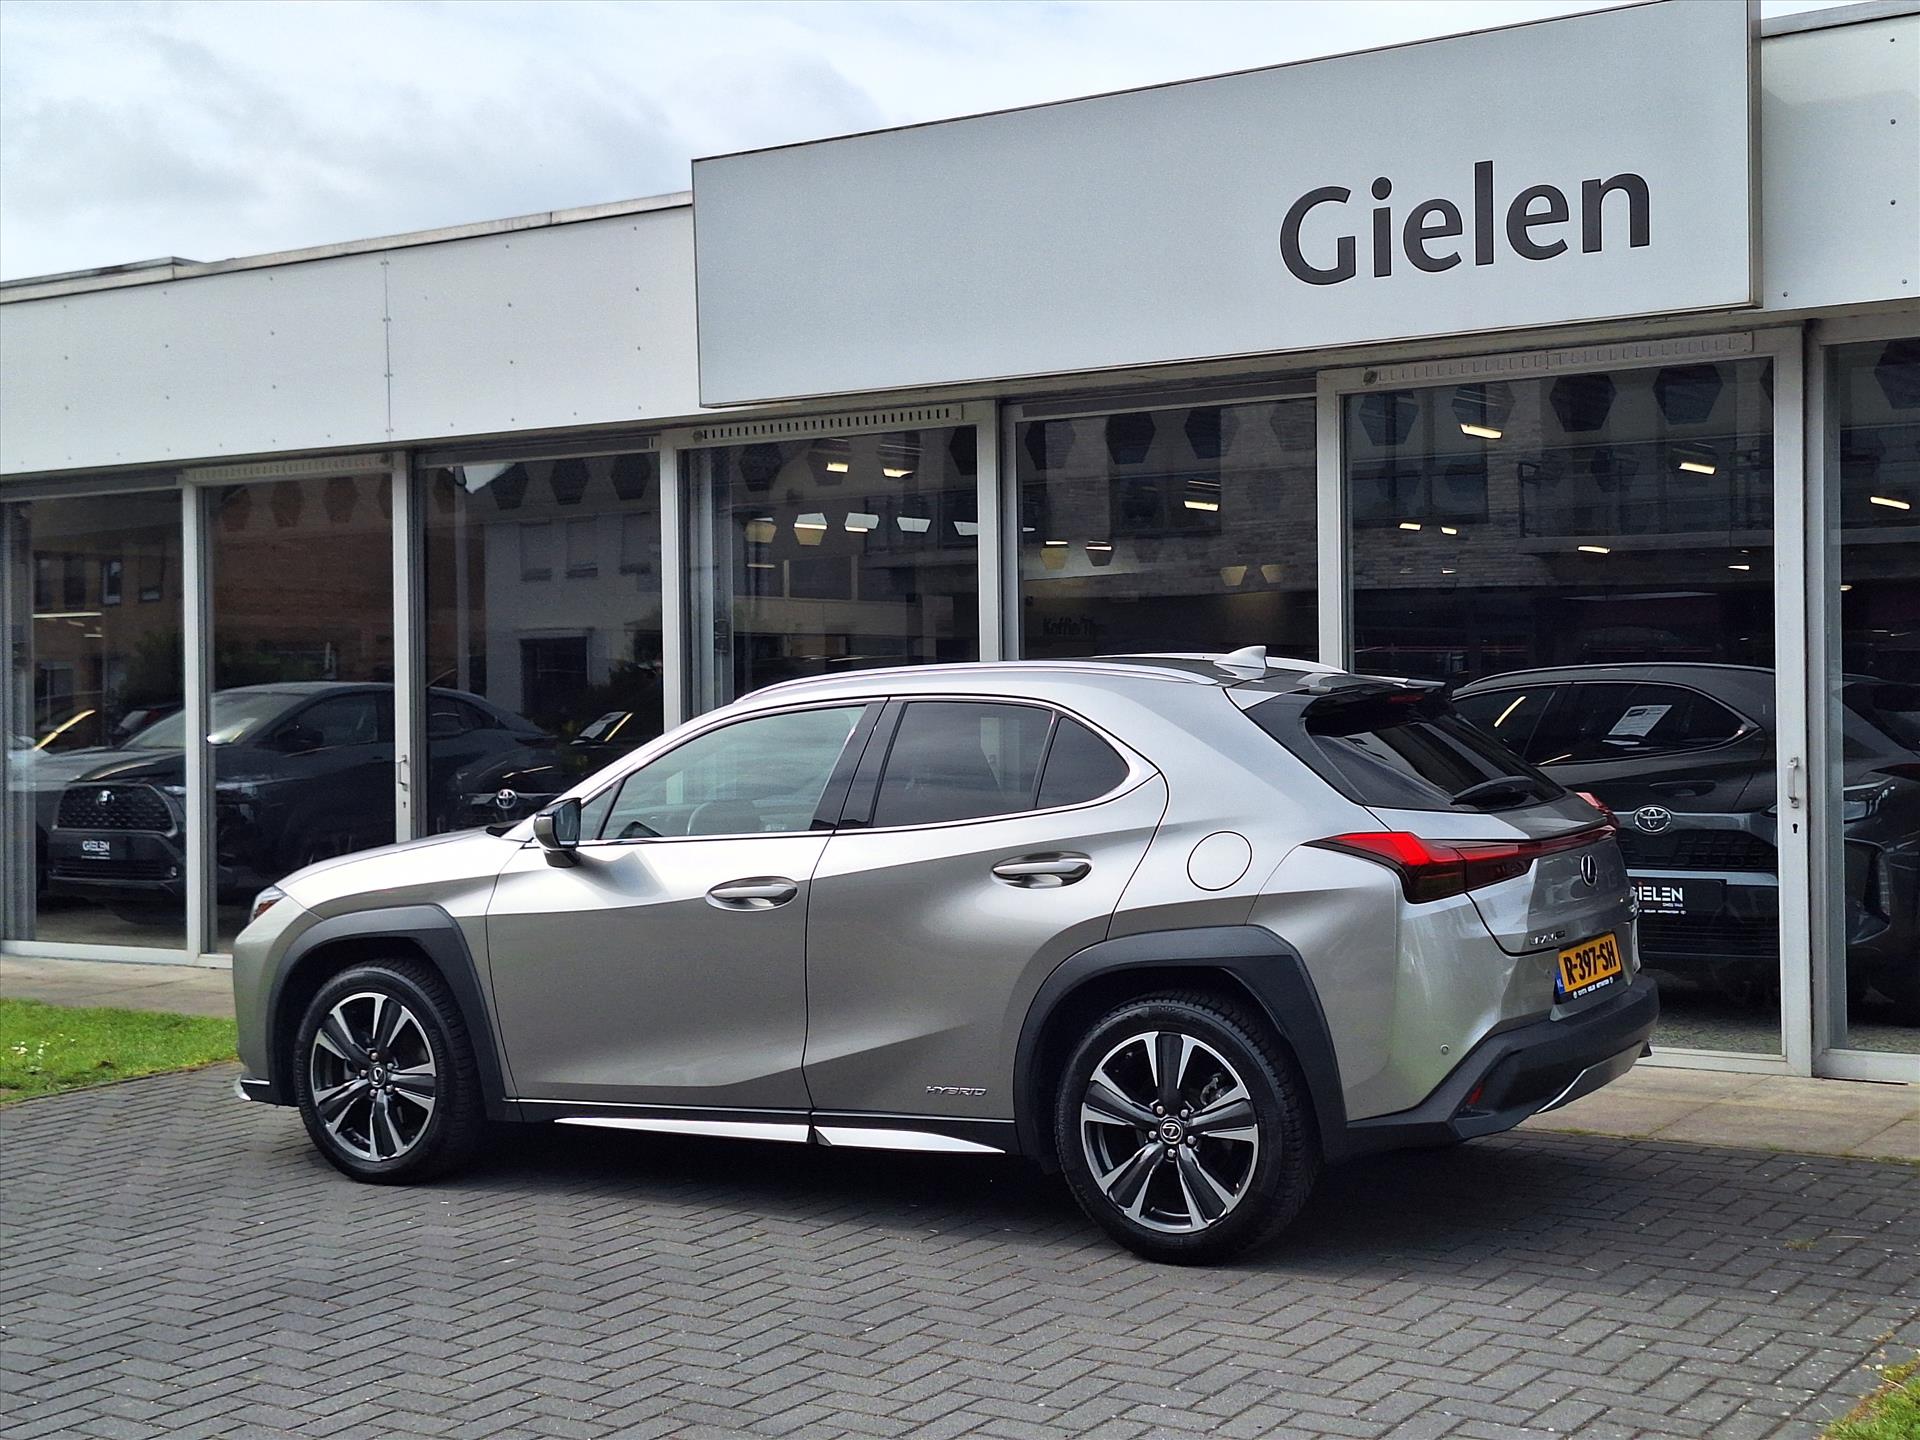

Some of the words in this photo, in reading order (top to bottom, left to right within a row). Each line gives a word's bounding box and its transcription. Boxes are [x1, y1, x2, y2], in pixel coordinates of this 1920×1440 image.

[1280, 160, 1651, 286] Gielen
[1563, 940, 1617, 986] R-397-SH
[926, 1085, 987, 1096] HYBRID
